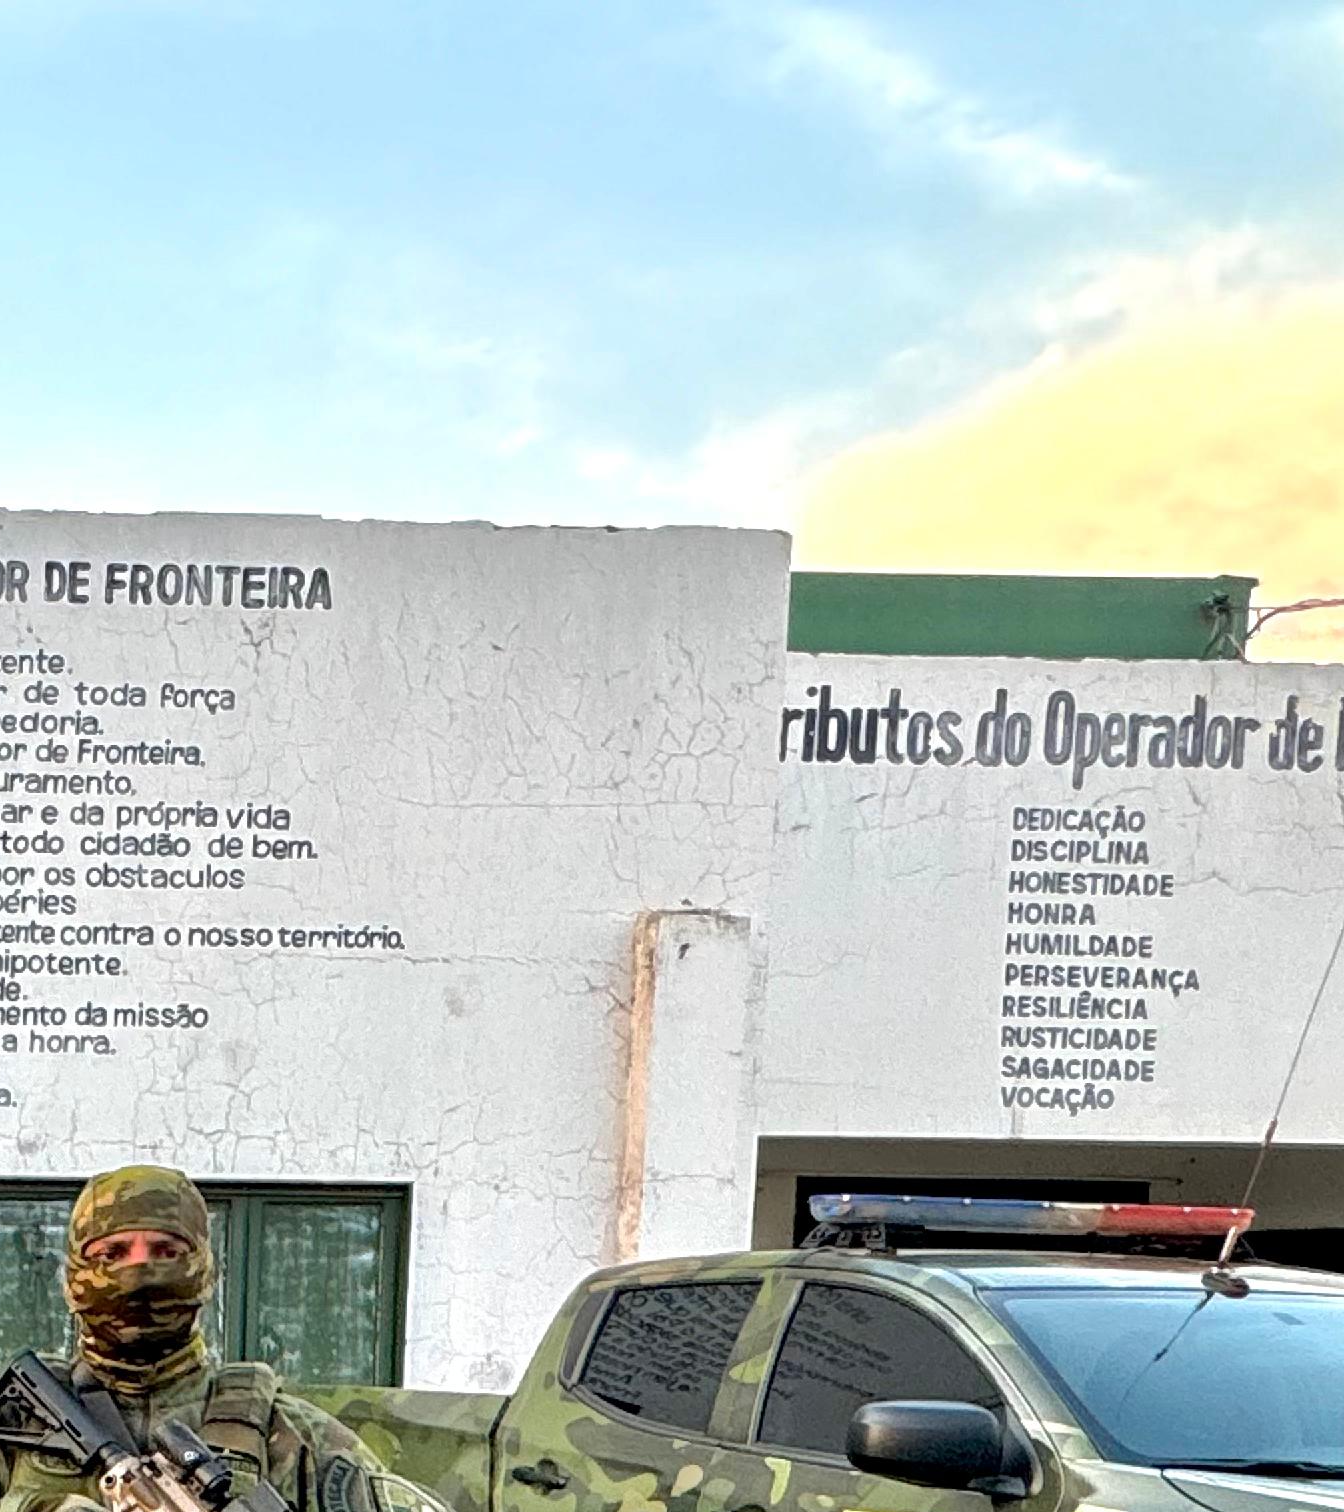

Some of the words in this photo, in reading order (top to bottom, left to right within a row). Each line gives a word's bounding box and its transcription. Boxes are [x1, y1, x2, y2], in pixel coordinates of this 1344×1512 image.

[44, 561, 92, 604] DE
[105, 562, 333, 610] FRONTEIRA
[23, 680, 59, 705] de
[74, 681, 147, 707] toda
[160, 682, 236, 716] força
[35, 738, 70, 763] de
[975, 689, 1032, 768] do
[1042, 690, 1262, 790] Operador
[1268, 695, 1326, 773] de
[40, 805, 59, 825] e
[70, 802, 105, 826] da
[116, 801, 218, 831] própria
[226, 803, 291, 831] vida
[1012, 805, 1146, 840] DEDICAÇÃO
[0, 831, 65, 855] todo
[79, 831, 191, 858] cidadão
[207, 834, 244, 858] de
[1010, 839, 1150, 865] DISCIPLINA
[44, 865, 76, 885] os
[85, 862, 246, 890] obstaculos
[1008, 870, 1174, 897] HONESTIDADE
[1007, 901, 1097, 926] HONRA
[60, 922, 154, 947] contra
[164, 927, 181, 947] o
[187, 925, 273, 948] nosso
[1005, 932, 1154, 958] HUMILDADE
[1004, 963, 1201, 997] PERSEVERANÇA
[75, 1001, 108, 1027] da
[113, 1003, 209, 1029] missão
[1001, 990, 1149, 1020] RESILIÊNCIA
[1000, 1025, 1158, 1051] RUSTICIDADE
[1000, 1055, 1156, 1082] SAGACIDADE
[1000, 1082, 1116, 1118] VOCAÇÃO
